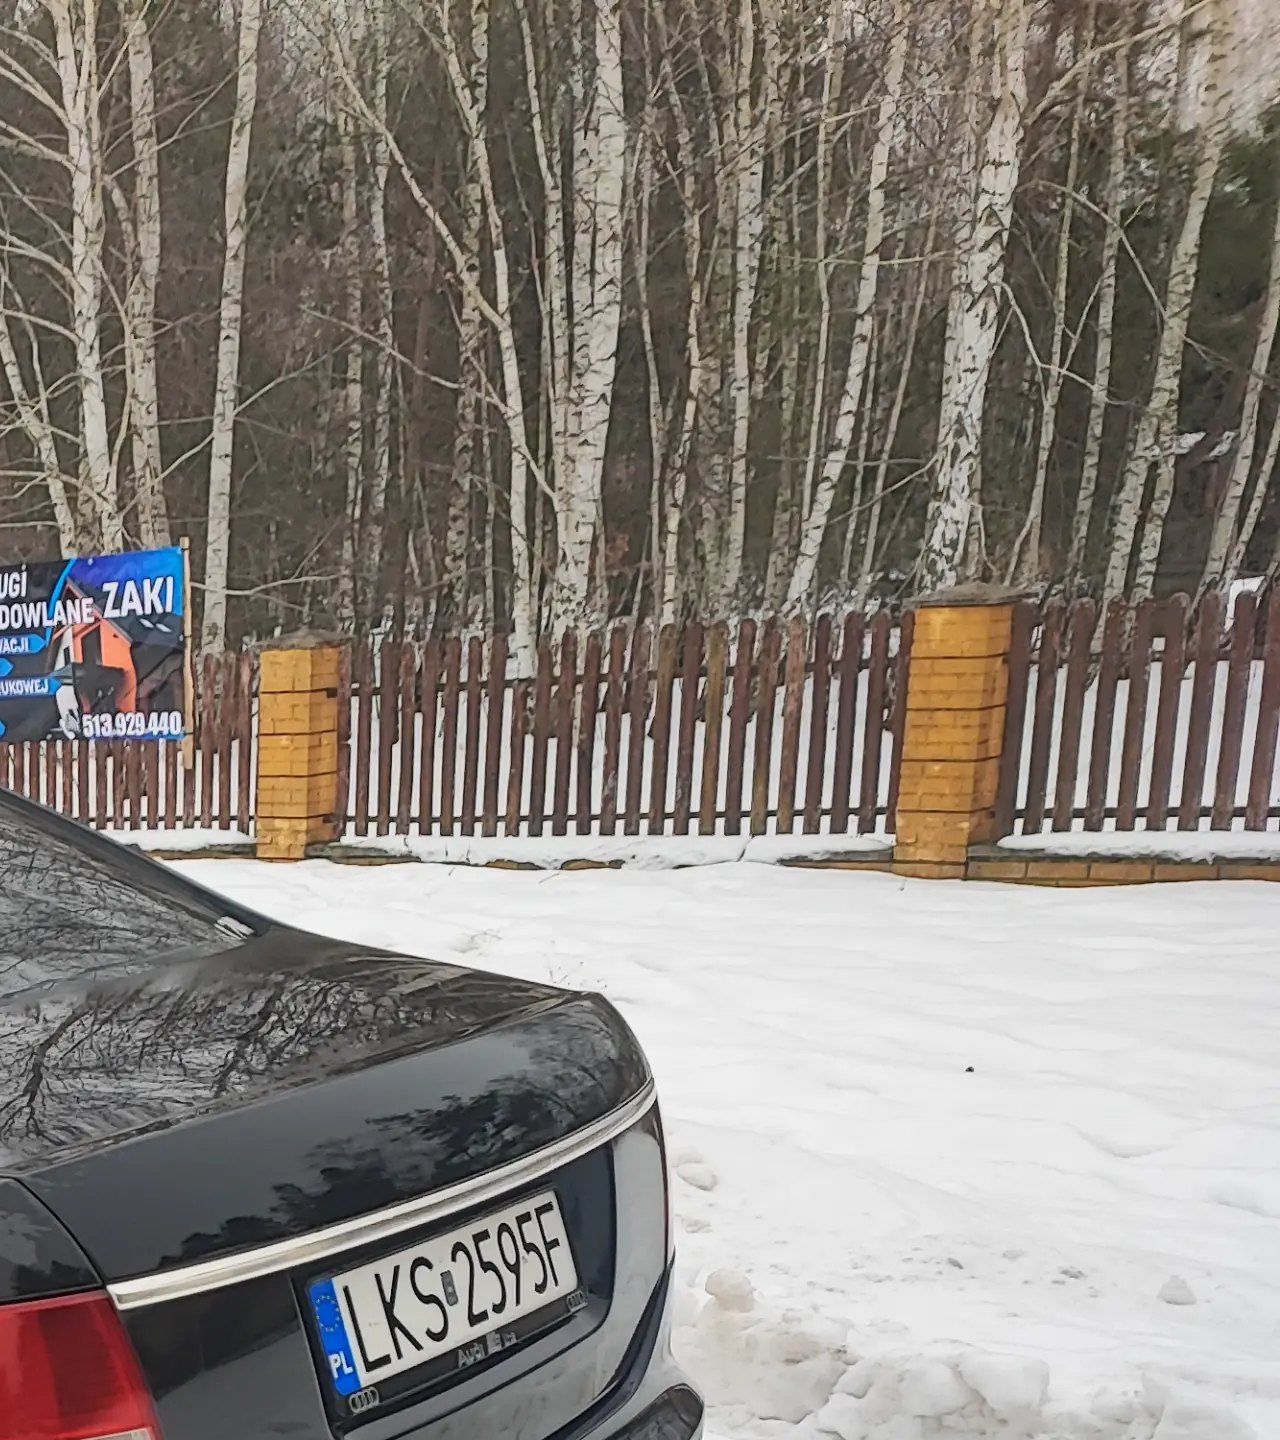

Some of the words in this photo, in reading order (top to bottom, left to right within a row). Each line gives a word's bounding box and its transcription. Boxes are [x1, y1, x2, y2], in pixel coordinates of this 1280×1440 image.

[102, 575, 175, 620] ZAKI
[342, 1256, 450, 1373] LKS
[451, 1201, 561, 1328] 2595F
[329, 1352, 354, 1379] PL
